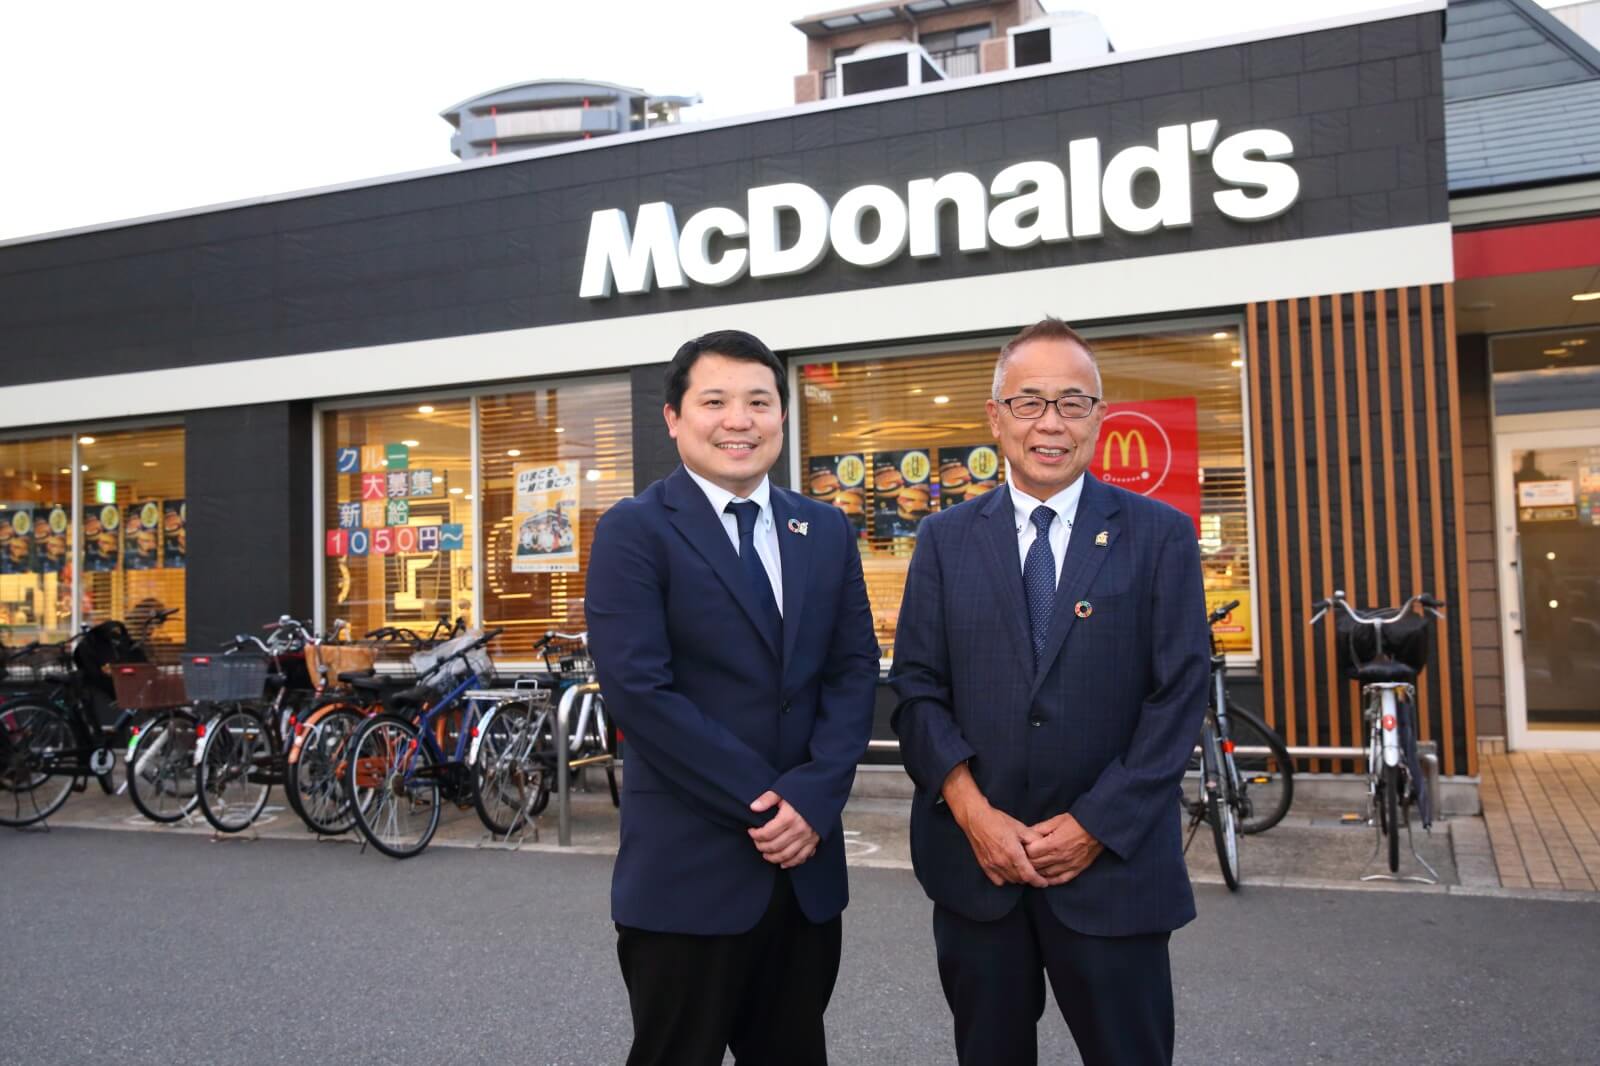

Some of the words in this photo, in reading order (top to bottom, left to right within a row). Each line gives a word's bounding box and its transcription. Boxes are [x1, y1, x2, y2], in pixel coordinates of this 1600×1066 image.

[578, 119, 1300, 298] McDonald's
[339, 448, 407, 472] クルー
[363, 470, 433, 499] 大募集
